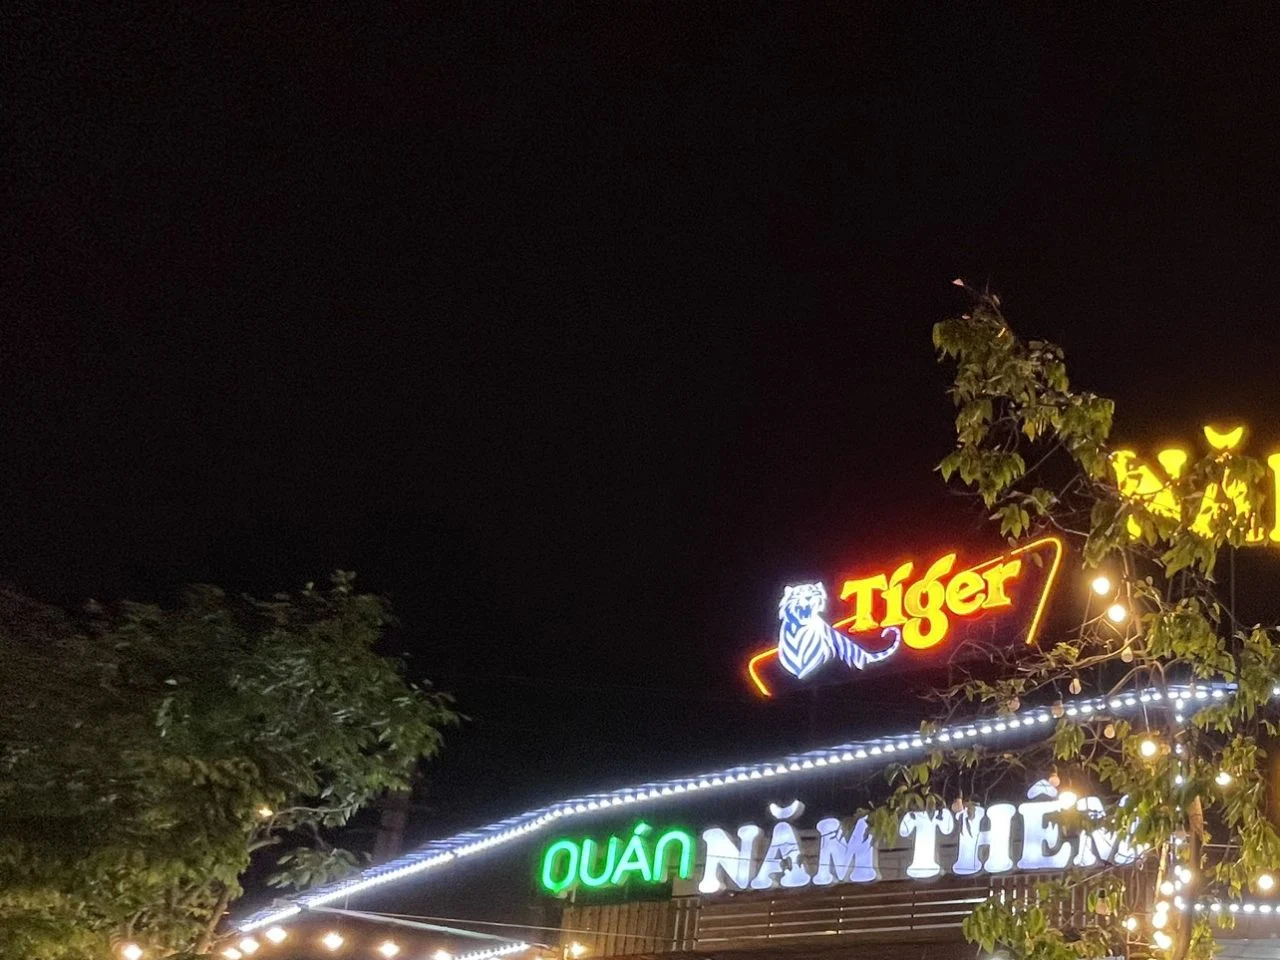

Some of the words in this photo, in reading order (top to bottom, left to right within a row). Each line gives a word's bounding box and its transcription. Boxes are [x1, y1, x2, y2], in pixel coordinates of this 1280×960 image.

[839, 553, 1022, 649] Tiger
[541, 822, 694, 891] QUÁN
[698, 799, 878, 894] NĂM
